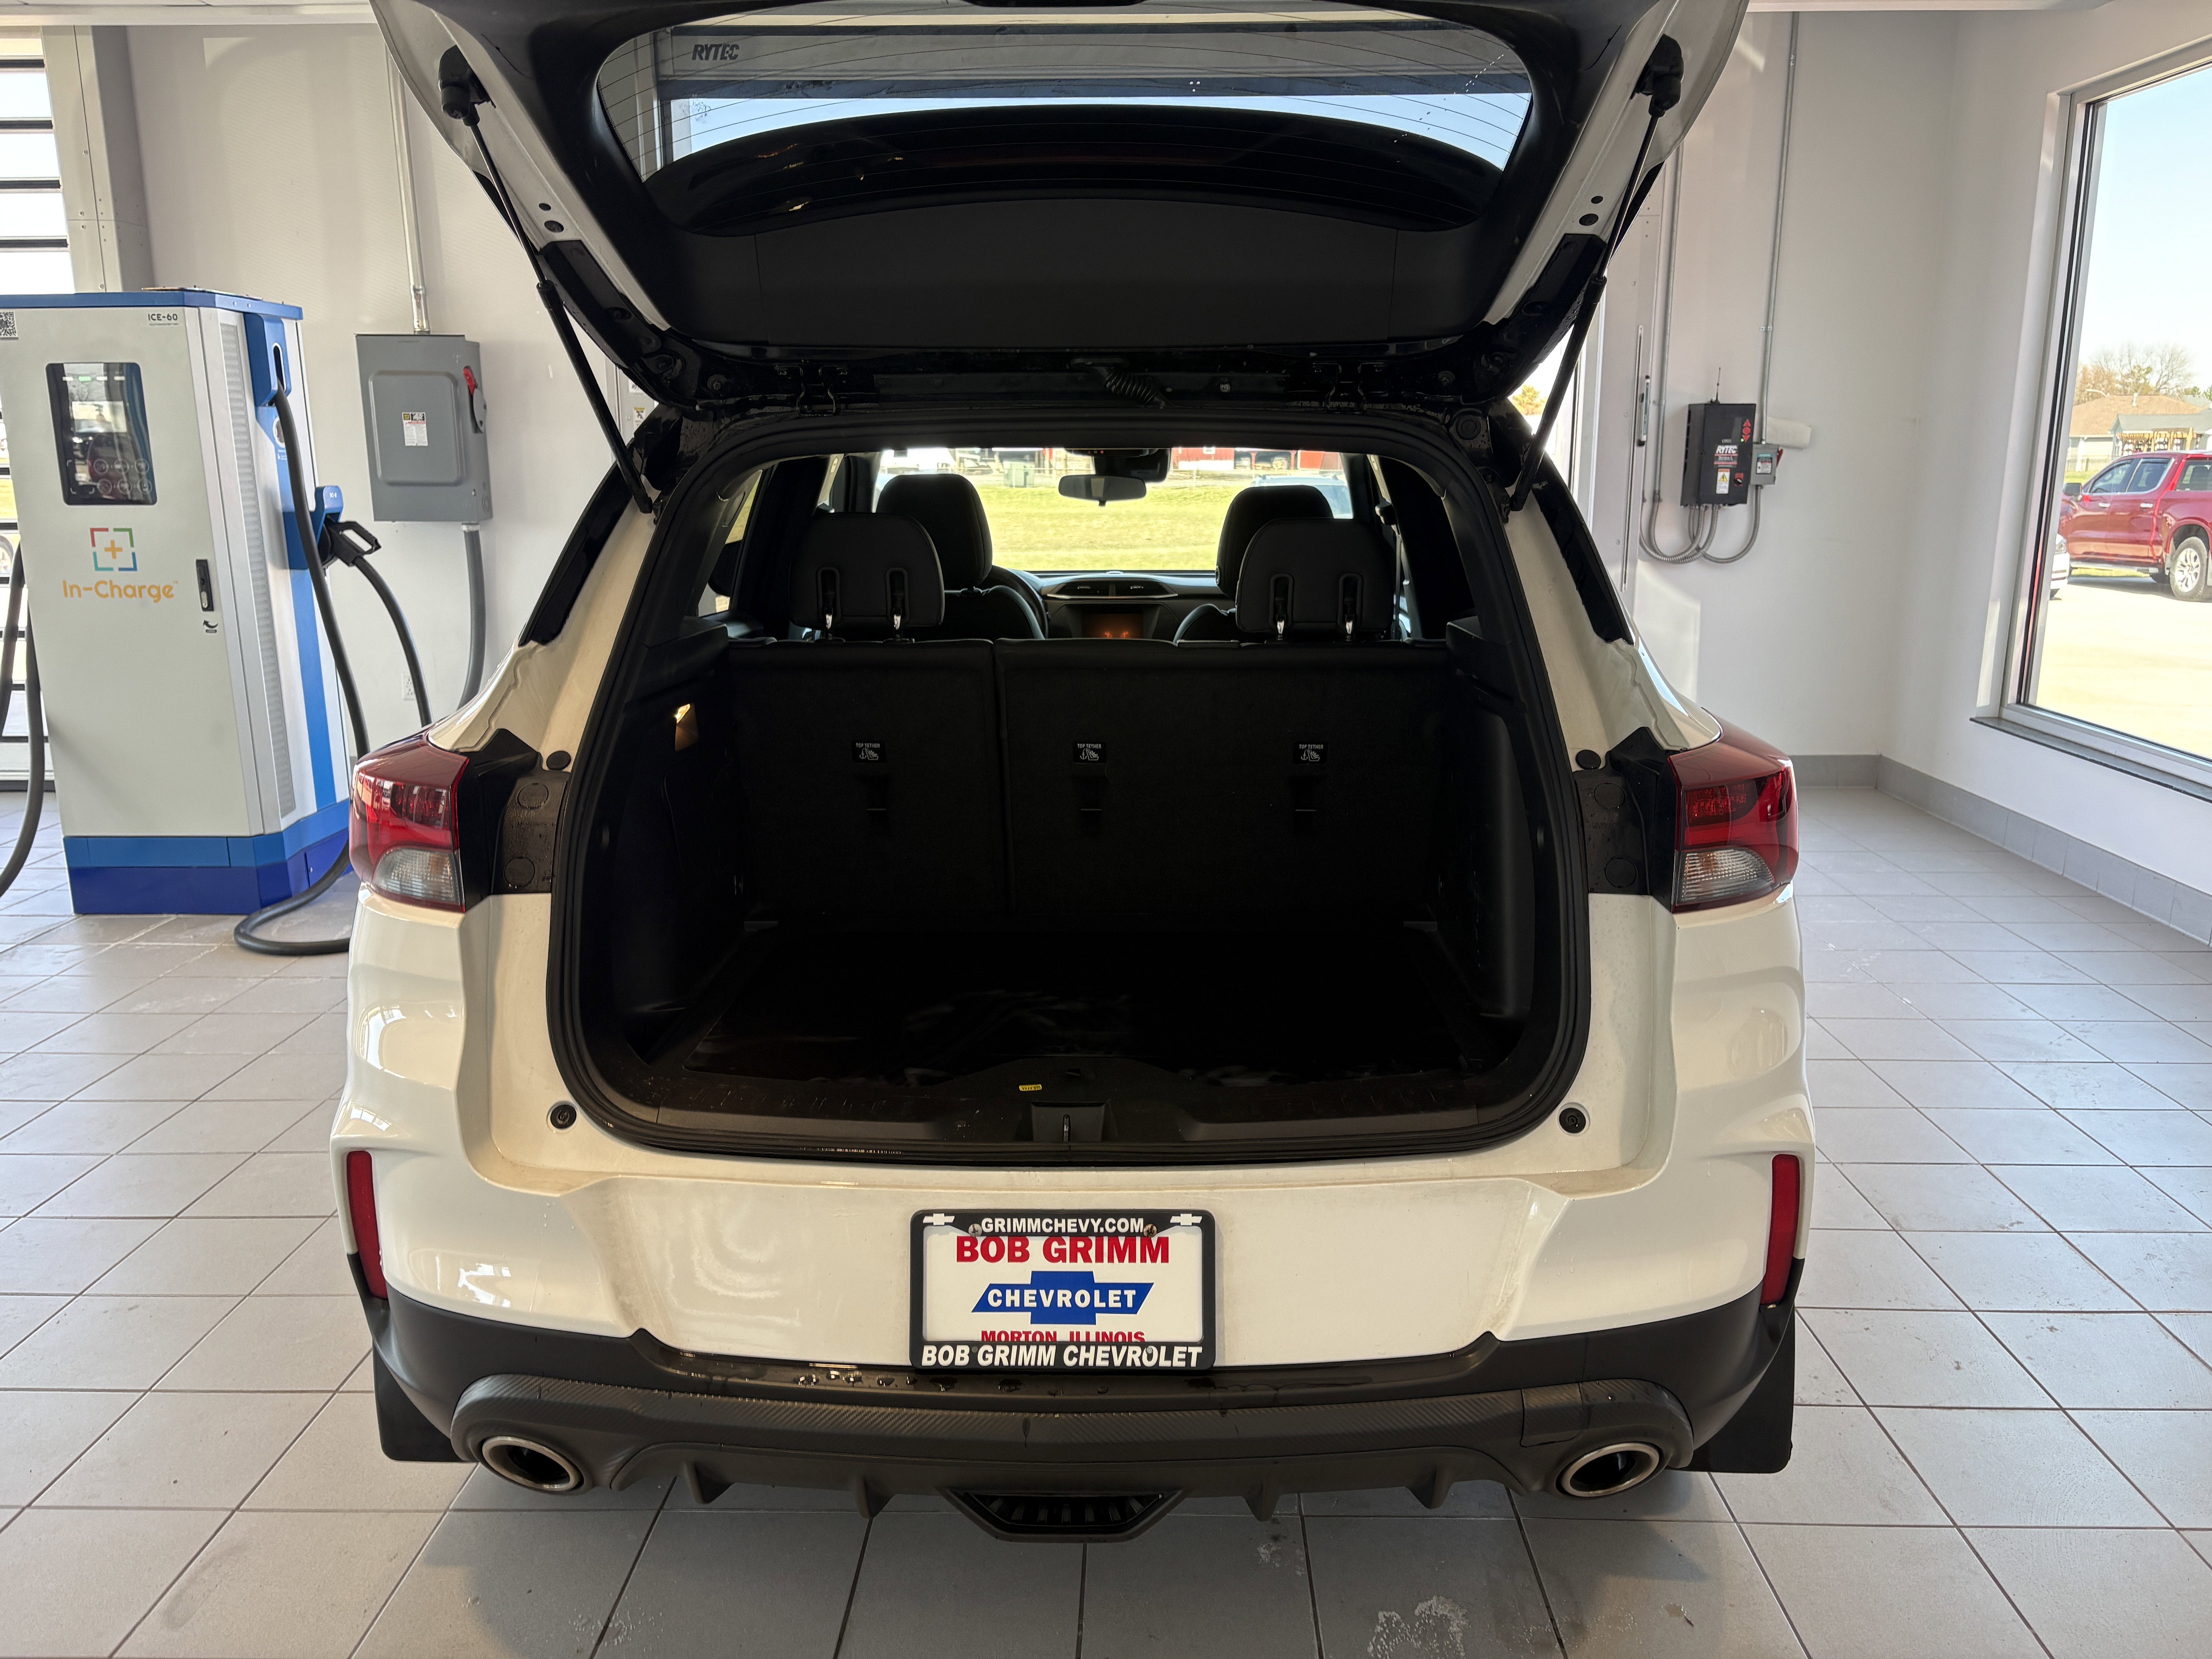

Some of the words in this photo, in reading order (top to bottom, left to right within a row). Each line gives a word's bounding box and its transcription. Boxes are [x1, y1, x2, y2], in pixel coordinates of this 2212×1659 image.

[692, 43, 740, 60] RYTEC
[62, 579, 175, 603] In-Charge
[981, 1218, 1144, 1233] GRIMMCHEVY.COM
[957, 1236, 1030, 1263] BOB
[1042, 1236, 1169, 1264] GRIMM
[988, 1289, 1137, 1308] CHEVROLET
[981, 1330, 1057, 1342] MORTON
[921, 1345, 970, 1366] BOB
[977, 1345, 1056, 1367] GRIMM
[1063, 1345, 1202, 1367] CHEVROLET
